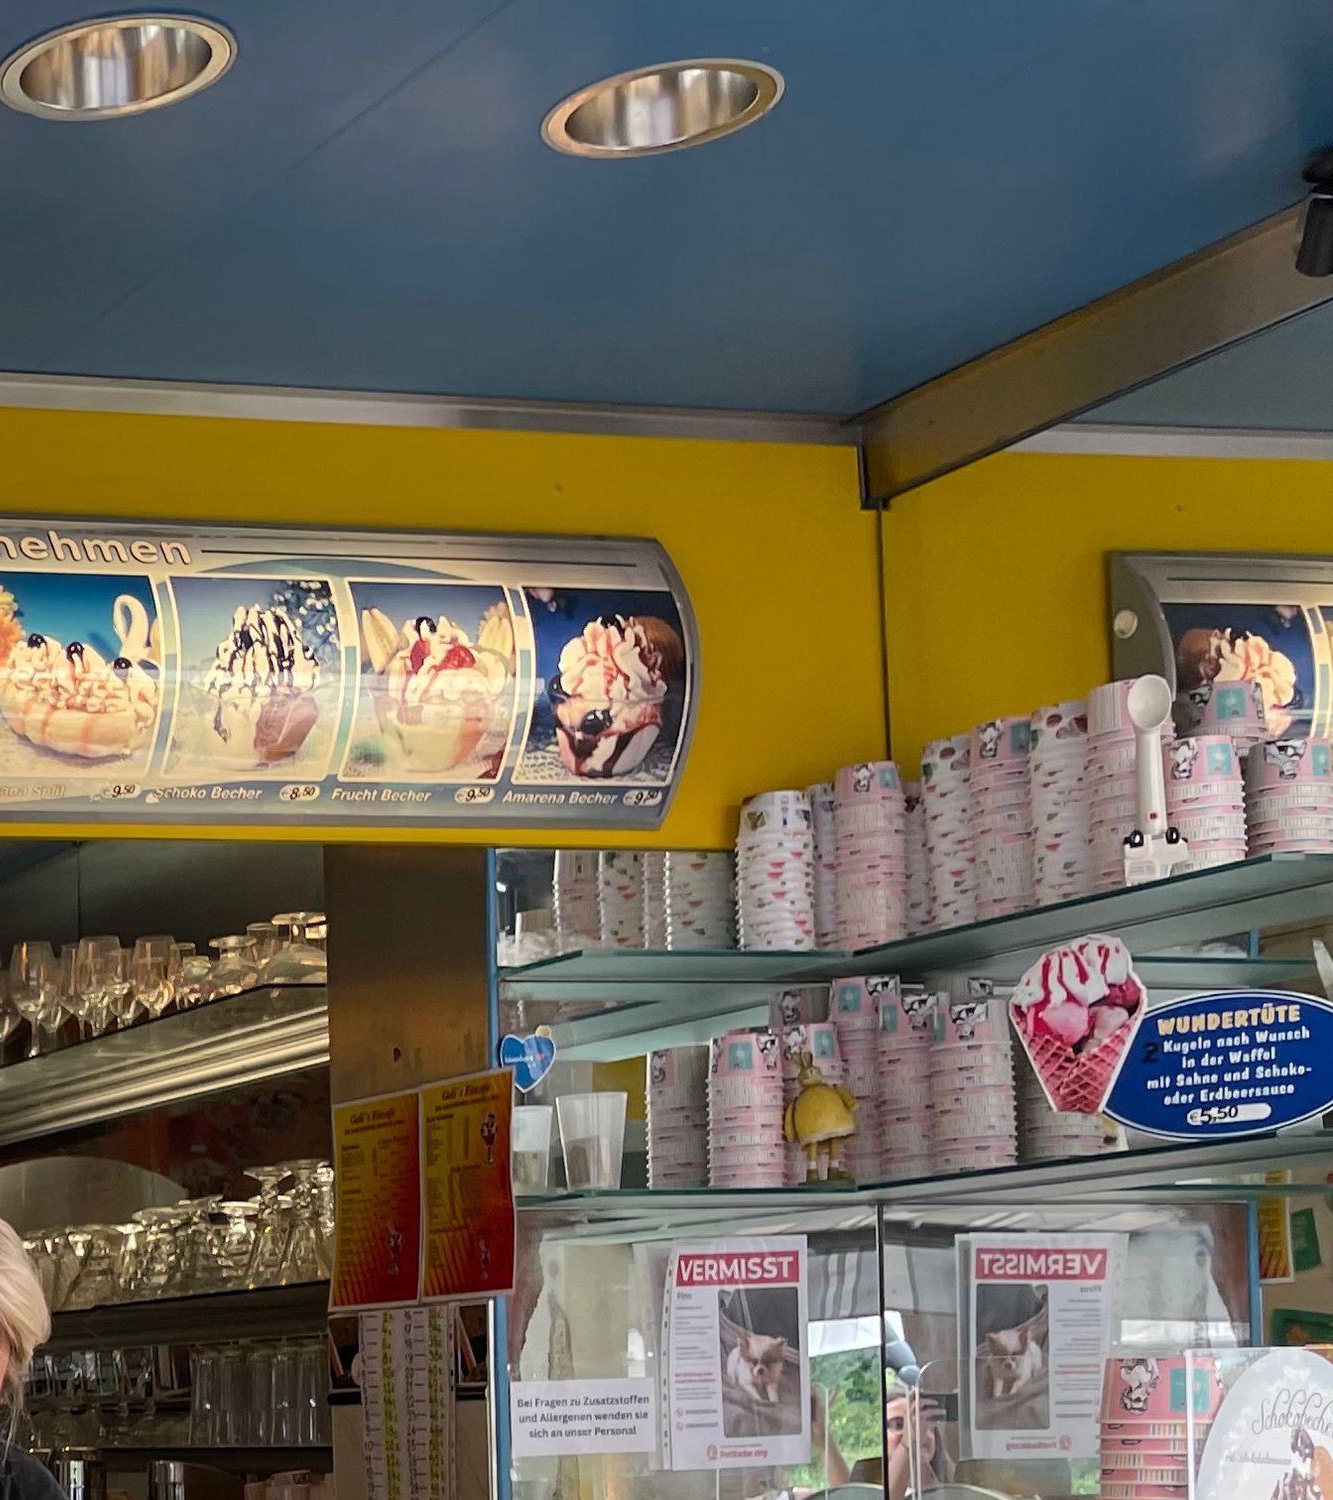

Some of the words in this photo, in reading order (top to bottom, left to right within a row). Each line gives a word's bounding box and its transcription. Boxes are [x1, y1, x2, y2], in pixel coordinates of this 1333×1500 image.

[33, 783, 67, 799] Split
[155, 785, 207, 800] Schoko
[210, 787, 263, 801] Becher
[331, 787, 383, 802] Frucht
[386, 788, 432, 804] Becher
[502, 791, 561, 805] Amarena
[563, 791, 618, 806] Becher
[1156, 1002, 1301, 1037] WUNDERTÜTE
[1163, 1036, 1211, 1054] Kugeln
[1216, 1032, 1250, 1048] nach
[1255, 1026, 1310, 1044] Wunsch
[1201, 1053, 1223, 1067] der
[1229, 1047, 1276, 1064] Waffel
[1146, 1075, 1171, 1091] mit
[1176, 1071, 1219, 1087] Sahne
[1223, 1066, 1250, 1082] und
[1255, 1062, 1312, 1079] Schoko-
[1163, 1090, 1195, 1106] oder
[1200, 1082, 1295, 1102] Erdbeersauce
[679, 1255, 794, 1283] VERMISST
[517, 1398, 533, 1408] Bei
[535, 1397, 568, 1410] Fragen
[570, 1397, 581, 1407] zu
[583, 1394, 650, 1406] Zusatzstoffen
[519, 1413, 537, 1424] und
[539, 1412, 593, 1425] Allergenen
[594, 1411, 633, 1421] wenden
[1252, 1388, 1333, 1438] Schokobeche
[529, 1427, 549, 1439] sich
[551, 1429, 563, 1438] an
[565, 1427, 592, 1438] unser
[594, 1425, 637, 1437] Personal
